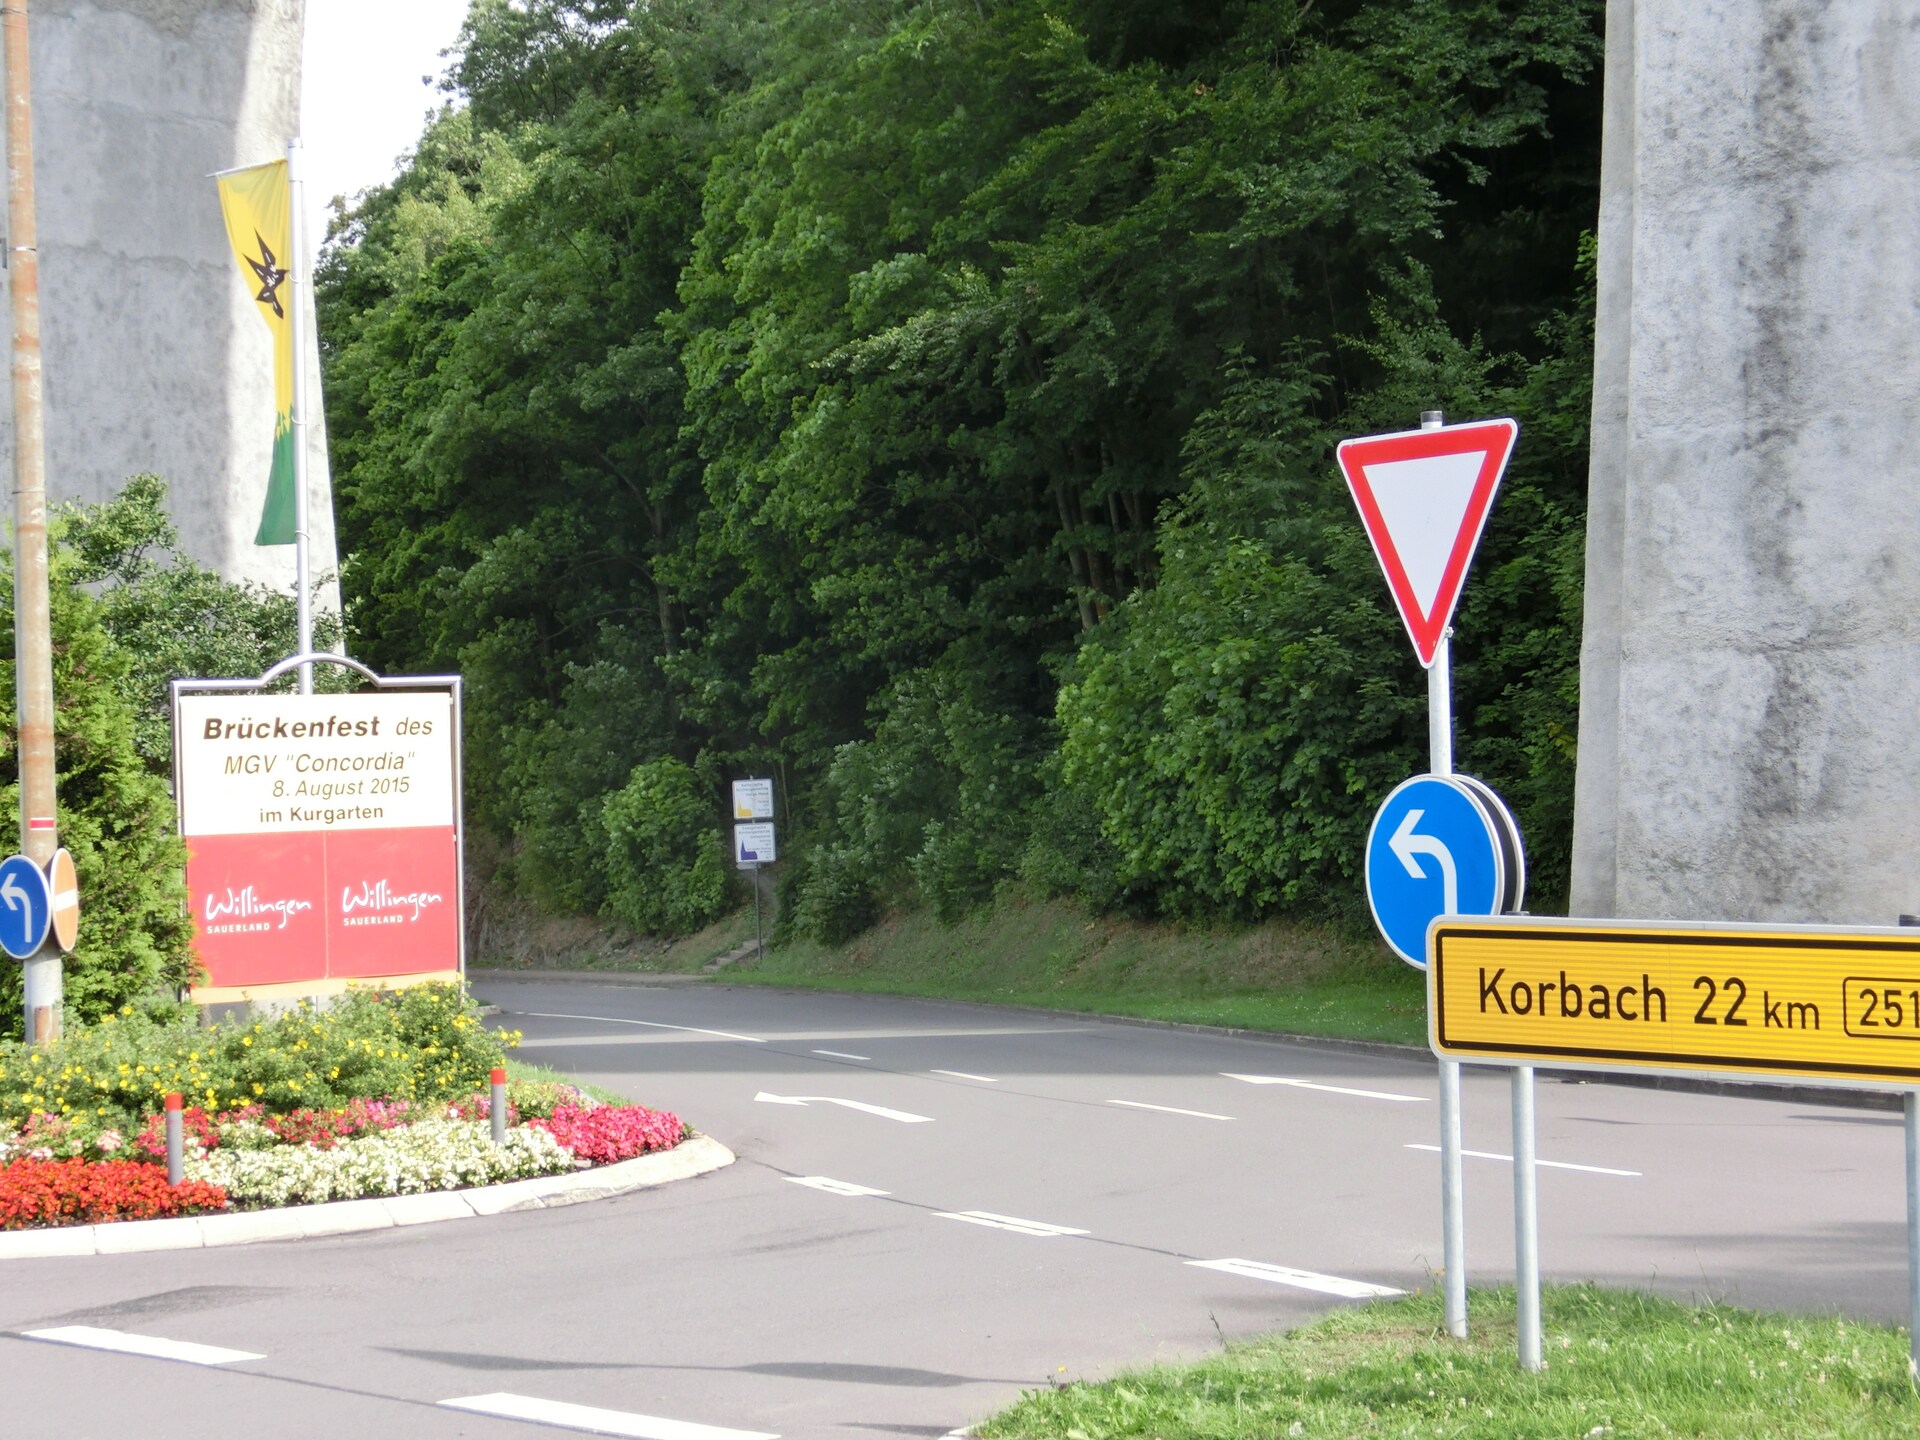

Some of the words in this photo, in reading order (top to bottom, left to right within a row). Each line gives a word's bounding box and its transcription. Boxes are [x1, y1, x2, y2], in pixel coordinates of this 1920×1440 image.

[203, 715, 380, 740] Brückenfest
[395, 716, 433, 736] des
[224, 754, 278, 775] MGV
[286, 751, 416, 773] "Concordia"
[272, 780, 290, 797] 8.
[295, 779, 364, 800] August
[370, 777, 411, 795] 2015
[259, 808, 282, 823] im
[290, 807, 384, 824] Kurgarten
[205, 885, 312, 929] Willingen
[342, 879, 442, 921] Willingen
[207, 922, 270, 934] SAUERLAND
[343, 915, 404, 926] SAUERLAND
[1478, 967, 1667, 1023] Korbach
[1692, 976, 1748, 1026] 22
[1763, 991, 1820, 1031] km
[1859, 988, 1920, 1028] 251
